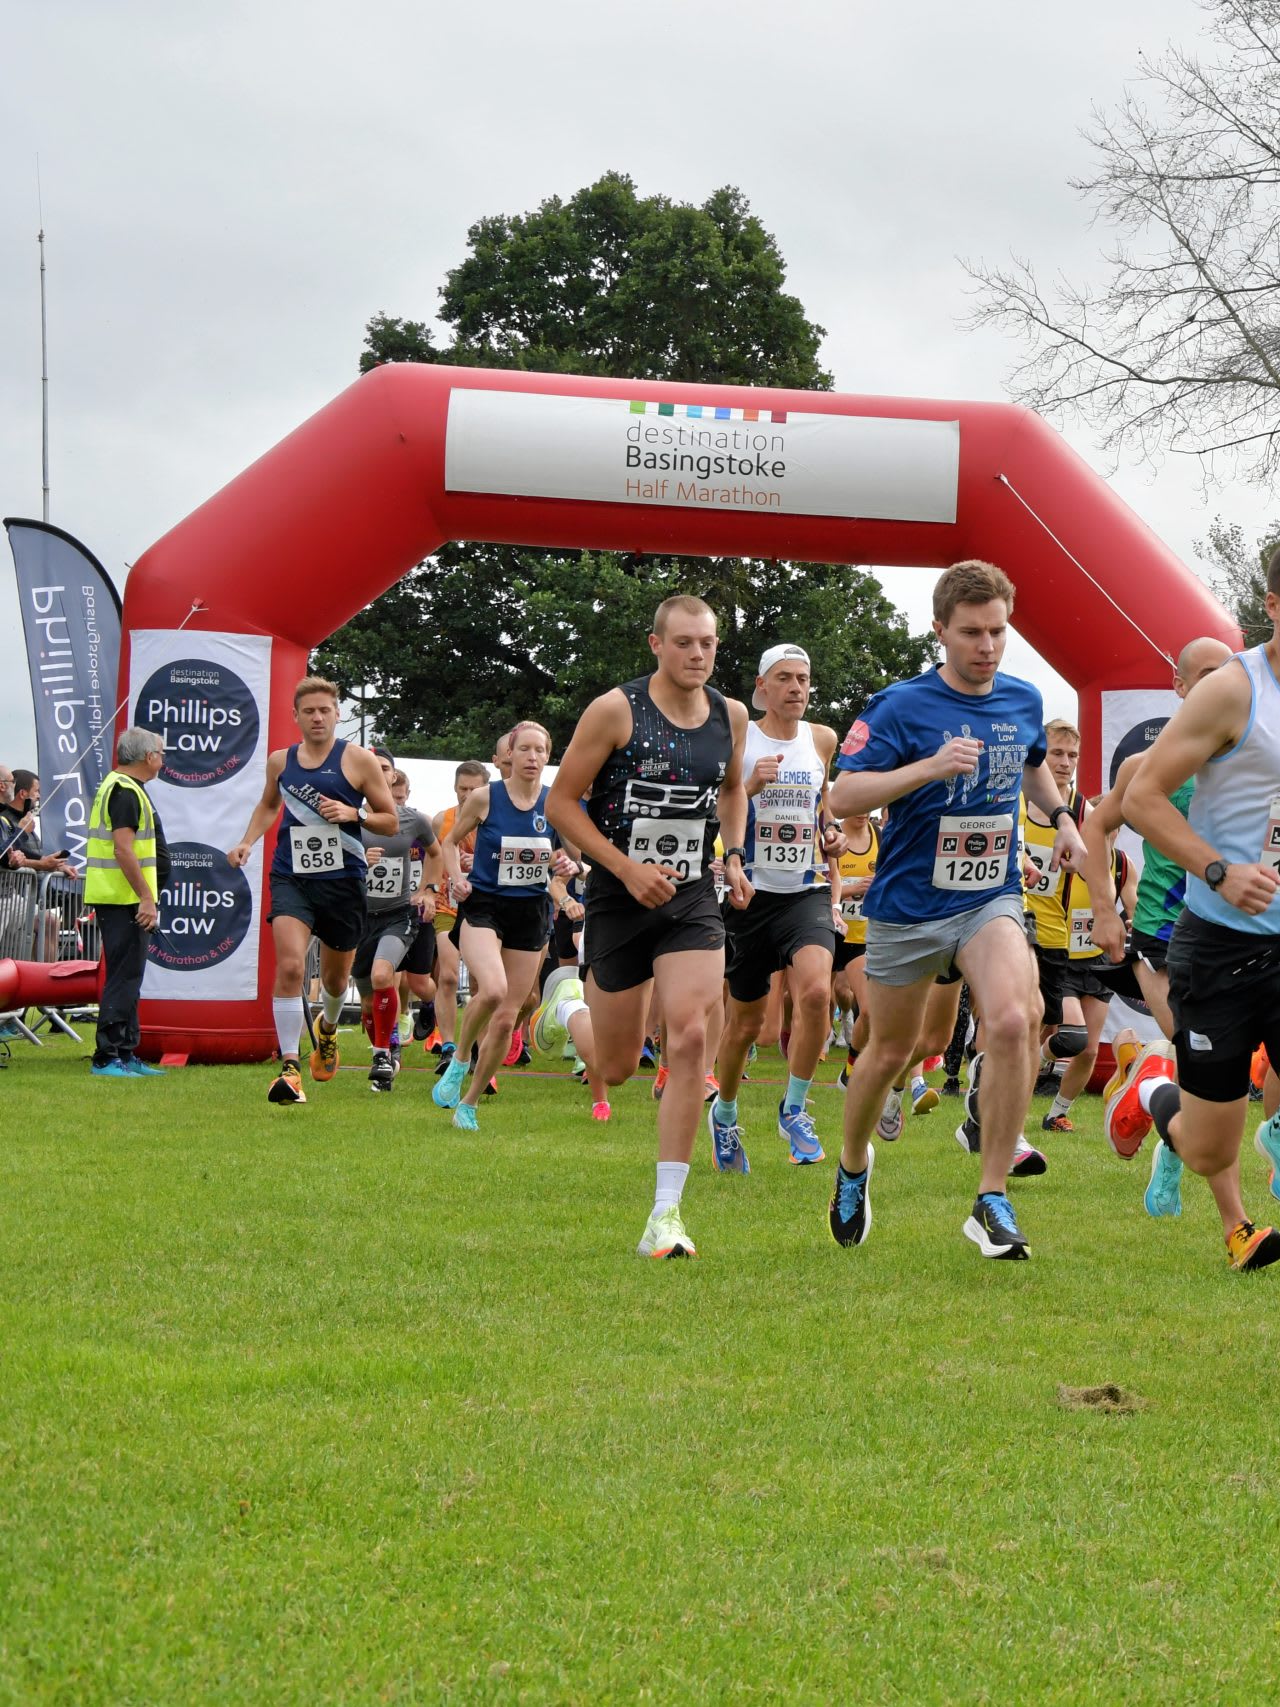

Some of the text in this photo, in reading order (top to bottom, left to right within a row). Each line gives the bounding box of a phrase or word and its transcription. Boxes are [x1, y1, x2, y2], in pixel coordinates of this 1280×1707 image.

[626, 420, 784, 452] destination
[626, 445, 786, 480] Basingstoke
[626, 478, 781, 507] Half Marathon
[170, 667, 219, 677] destination
[170, 676, 220, 686] Basingstoke
[148, 698, 242, 731] Phillips
[991, 723, 1018, 734] Phillips
[997, 733, 1015, 742] Law
[162, 727, 222, 752] Law
[164, 754, 241, 782] Marathon & 10K
[988, 752, 1029, 768] HALF
[287, 784, 309, 803] ROAD
[760, 789, 795, 800] BORDER
[959, 821, 997, 829] GEORGE
[169, 852, 213, 860] estination
[300, 851, 335, 869] 658
[763, 845, 807, 863] 1331
[506, 865, 543, 880] 1396
[945, 859, 1000, 881] 1205
[157, 881, 235, 914] hillips
[157, 950, 209, 965] Marathon
[209, 949, 218, 958] &
[217, 937, 234, 953] 10K
